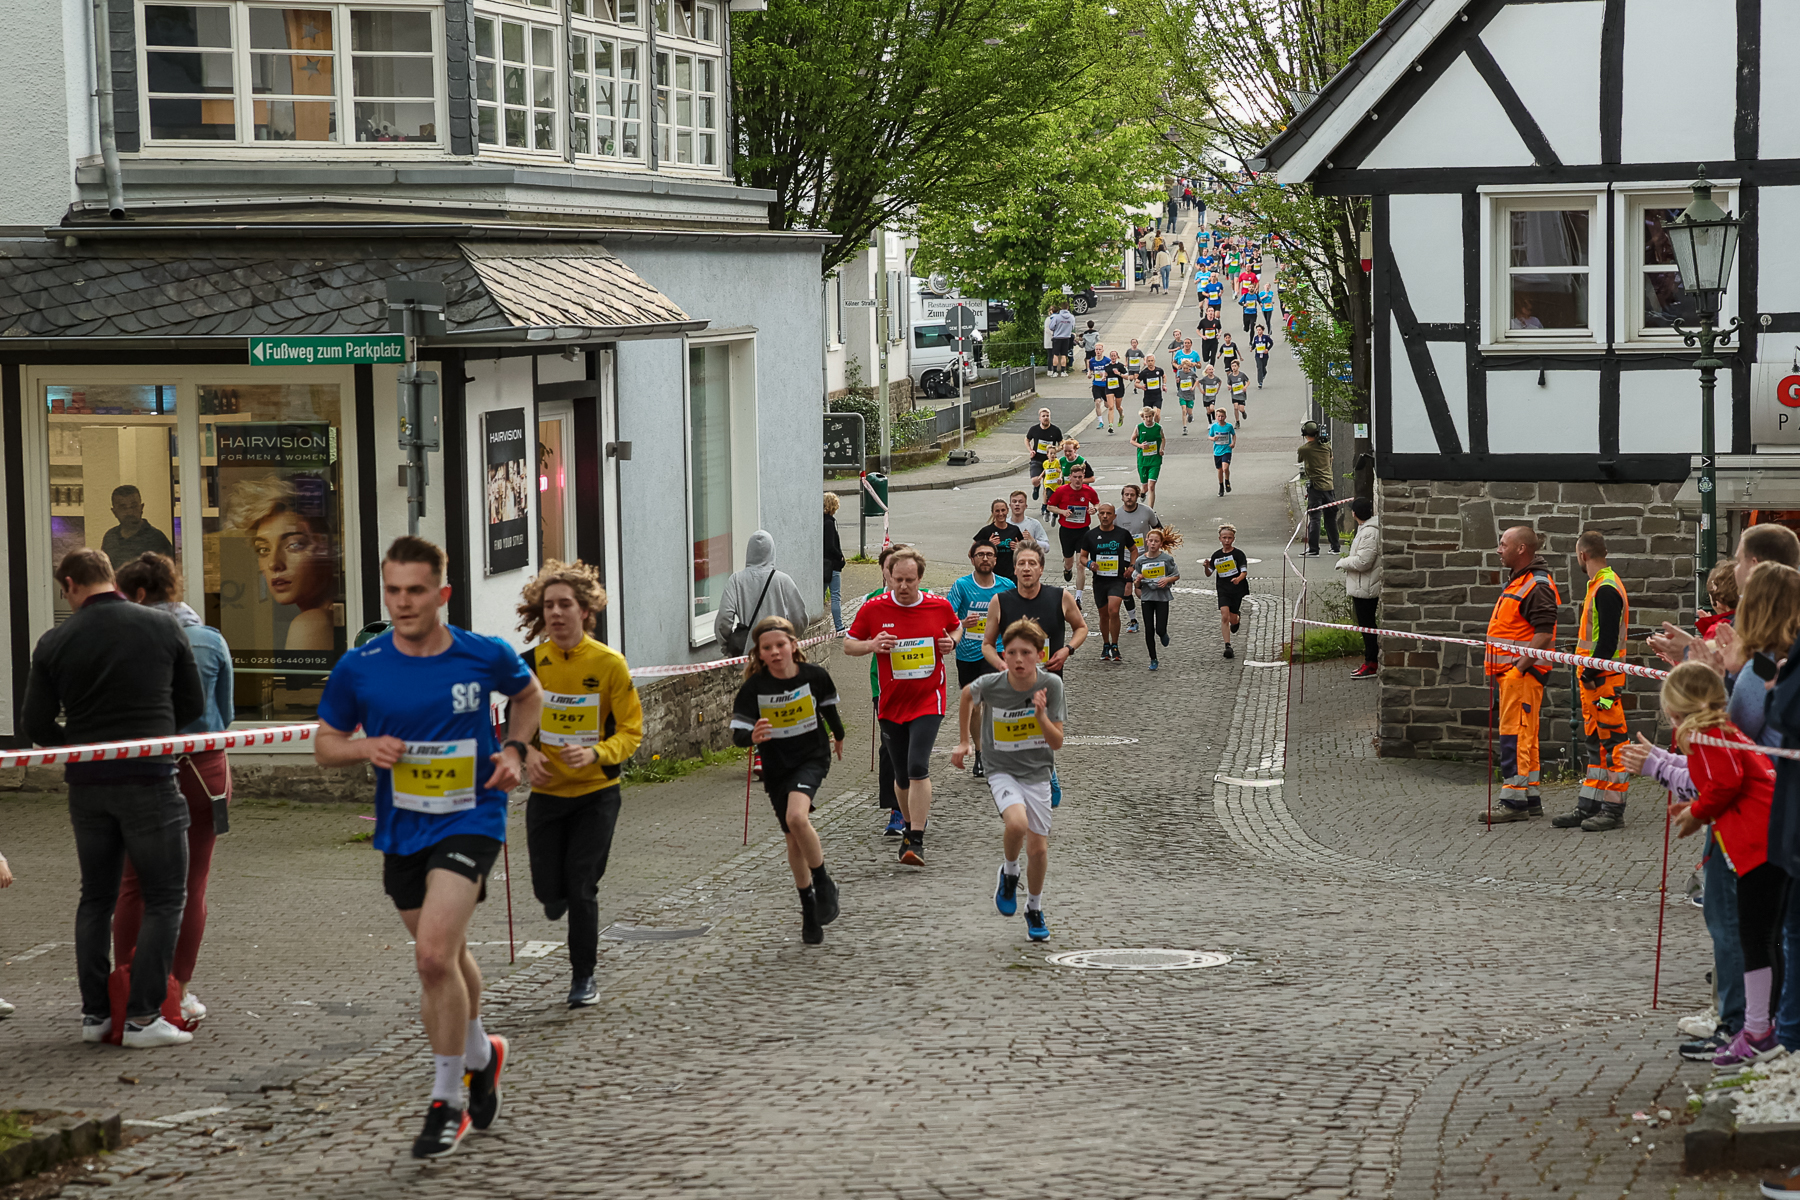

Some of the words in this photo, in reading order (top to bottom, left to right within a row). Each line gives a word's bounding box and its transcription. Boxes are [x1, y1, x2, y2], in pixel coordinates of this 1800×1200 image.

[265, 343, 314, 363] Fußweg
[317, 345, 343, 358] zum
[345, 342, 402, 362] Parkplatz
[220, 436, 326, 448] HAIRVISION
[489, 429, 522, 444] HAIRVISION
[220, 453, 242, 461] FOR
[246, 453, 271, 461] MEN
[274, 453, 282, 461] &
[285, 453, 327, 461] WOMEN
[451, 682, 481, 711] SC
[550, 695, 576, 704] LANG
[769, 694, 794, 703] LANG
[551, 713, 585, 722] 1267
[773, 706, 803, 718] 1224
[1003, 710, 1026, 718] LANG
[408, 745, 443, 755] LANG
[410, 768, 456, 780] 1574
